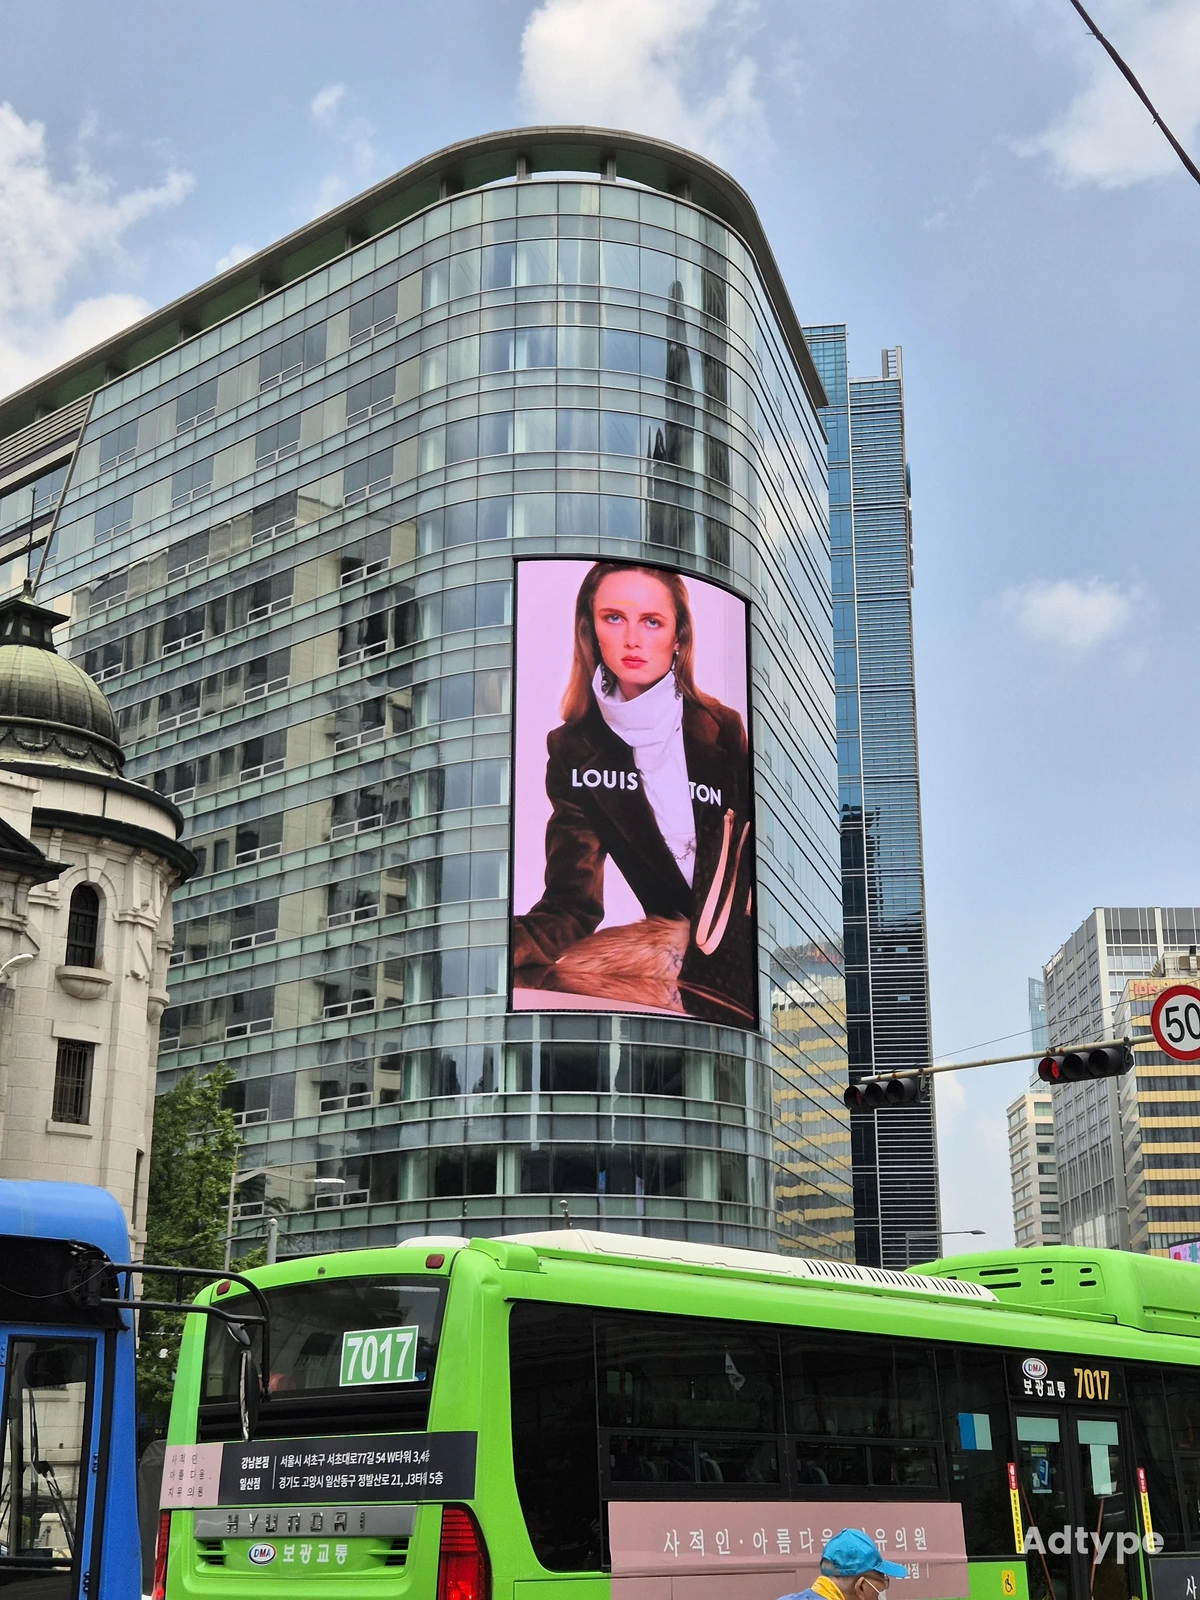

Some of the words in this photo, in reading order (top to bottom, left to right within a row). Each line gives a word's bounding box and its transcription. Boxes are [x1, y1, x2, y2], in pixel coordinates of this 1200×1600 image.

[571, 768, 639, 791] LOUIS
[1165, 1002, 1200, 1043] 50
[347, 1332, 414, 1381] 7017
[1027, 1363, 1043, 1373] DMA
[1023, 1378, 1066, 1399] 보광교통
[1073, 1367, 1110, 1401] 7017
[241, 1455, 270, 1470] 강남본점
[280, 1454, 302, 1468] 서울시
[303, 1453, 326, 1467] 서초구
[327, 1451, 375, 1467] 서초대로77길
[375, 1452, 386, 1464] 54
[386, 1449, 412, 1464] W타워
[239, 1477, 261, 1491] 일산점
[279, 1476, 300, 1489] 경기도
[301, 1475, 324, 1488] 고양시
[325, 1474, 356, 1488] 일산동구
[358, 1473, 390, 1488] 정발산로
[428, 1470, 444, 1485] 5층
[226, 1511, 366, 1534] HYUNDAI
[862, 1527, 928, 1552] 유의원
[253, 1548, 271, 1558] DMA
[282, 1543, 348, 1565] 보광교통
